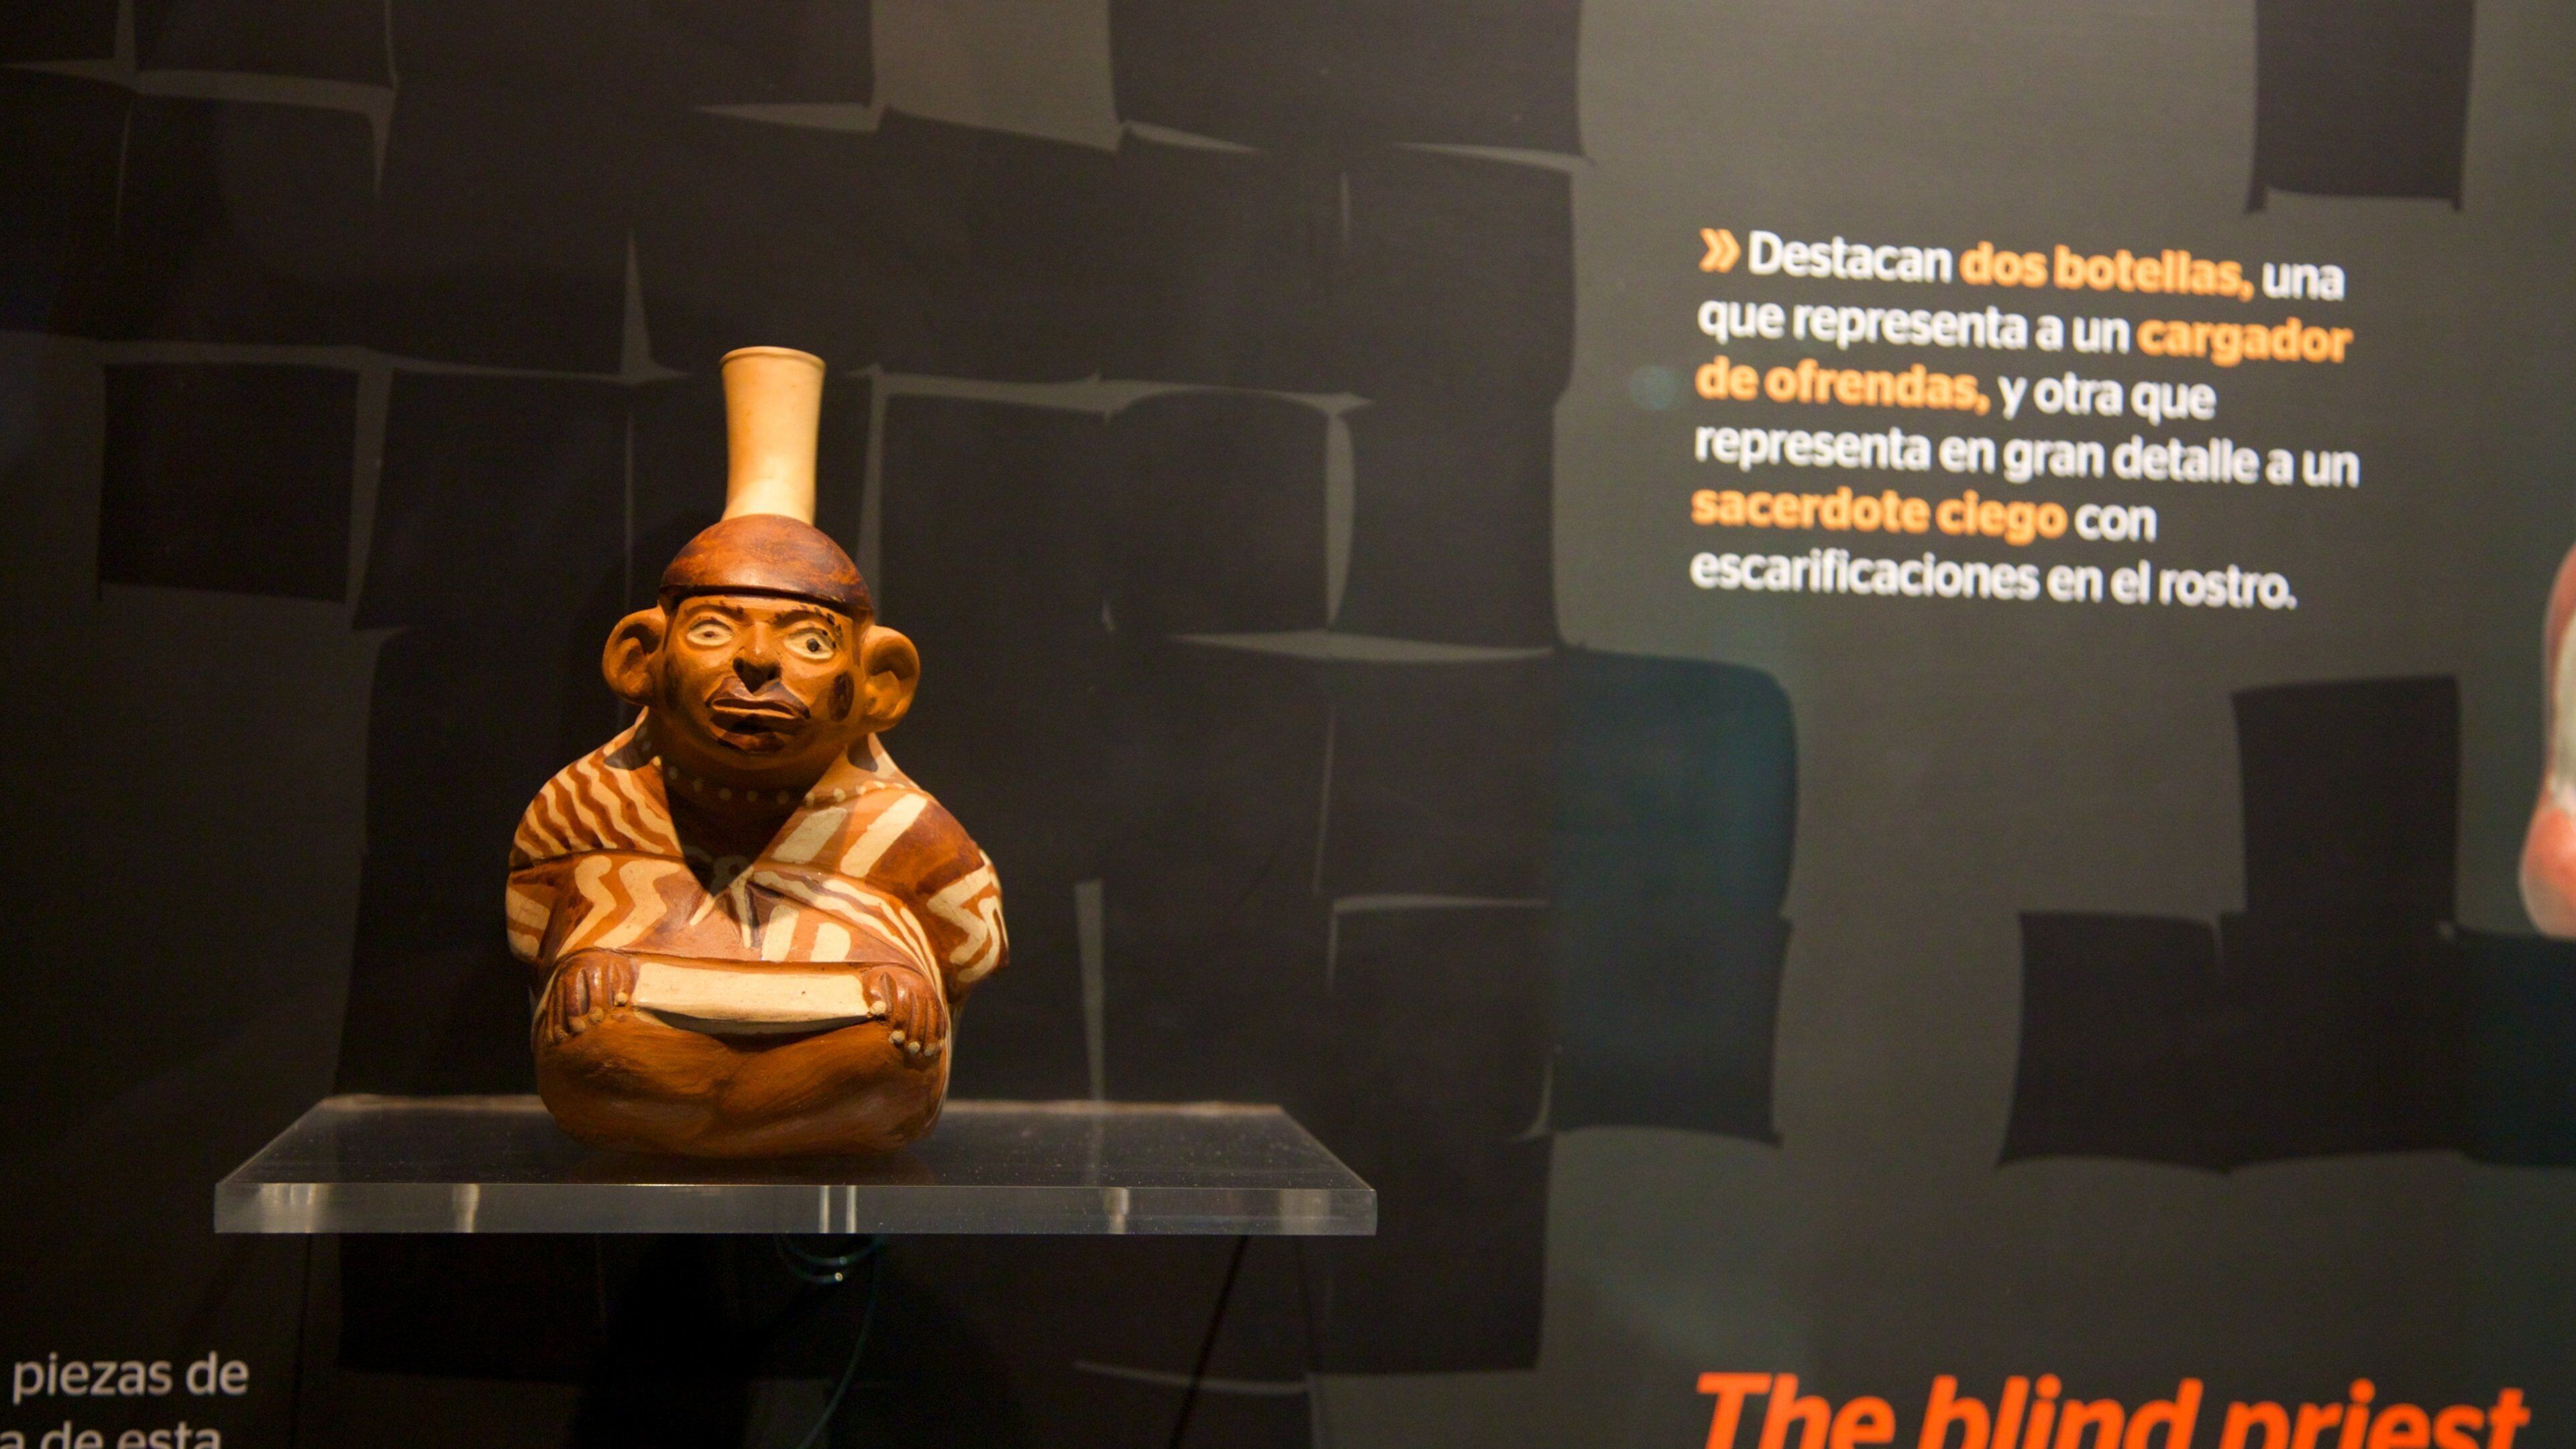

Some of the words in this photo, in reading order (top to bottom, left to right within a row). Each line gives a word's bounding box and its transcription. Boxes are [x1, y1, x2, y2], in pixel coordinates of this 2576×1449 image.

[1748, 231, 1952, 282] Destacan
[1959, 241, 2047, 287] dos
[2053, 244, 2254, 301] botellas,
[2262, 263, 2345, 301] una
[1698, 301, 1785, 344] que
[1793, 305, 2028, 350] representa
[2035, 315, 2064, 351] a
[2073, 317, 2130, 354] un
[2137, 317, 2353, 367] cargador
[1695, 356, 1759, 400] de
[1764, 358, 1990, 415] ofrendas,
[1998, 377, 2027, 419] y
[2033, 372, 2123, 415] otra
[2131, 382, 2216, 425] que
[1695, 427, 1931, 471] representa
[1939, 437, 1996, 472] en
[2003, 439, 2105, 483] gran
[2112, 435, 2260, 483] detalle
[2265, 449, 2294, 484] a
[2302, 451, 2360, 486] un
[1691, 486, 1931, 533] sacerdote
[1935, 490, 2068, 545] ciego
[2074, 504, 2157, 541] con
[1690, 548, 2040, 600] escarificaciones
[2047, 566, 2103, 602] en
[2110, 560, 2151, 603] el
[2159, 565, 2297, 608] rostro.
[13, 1352, 172, 1404] piezas
[186, 1351, 249, 1394] de
[1697, 1373, 1895, 1449] The
